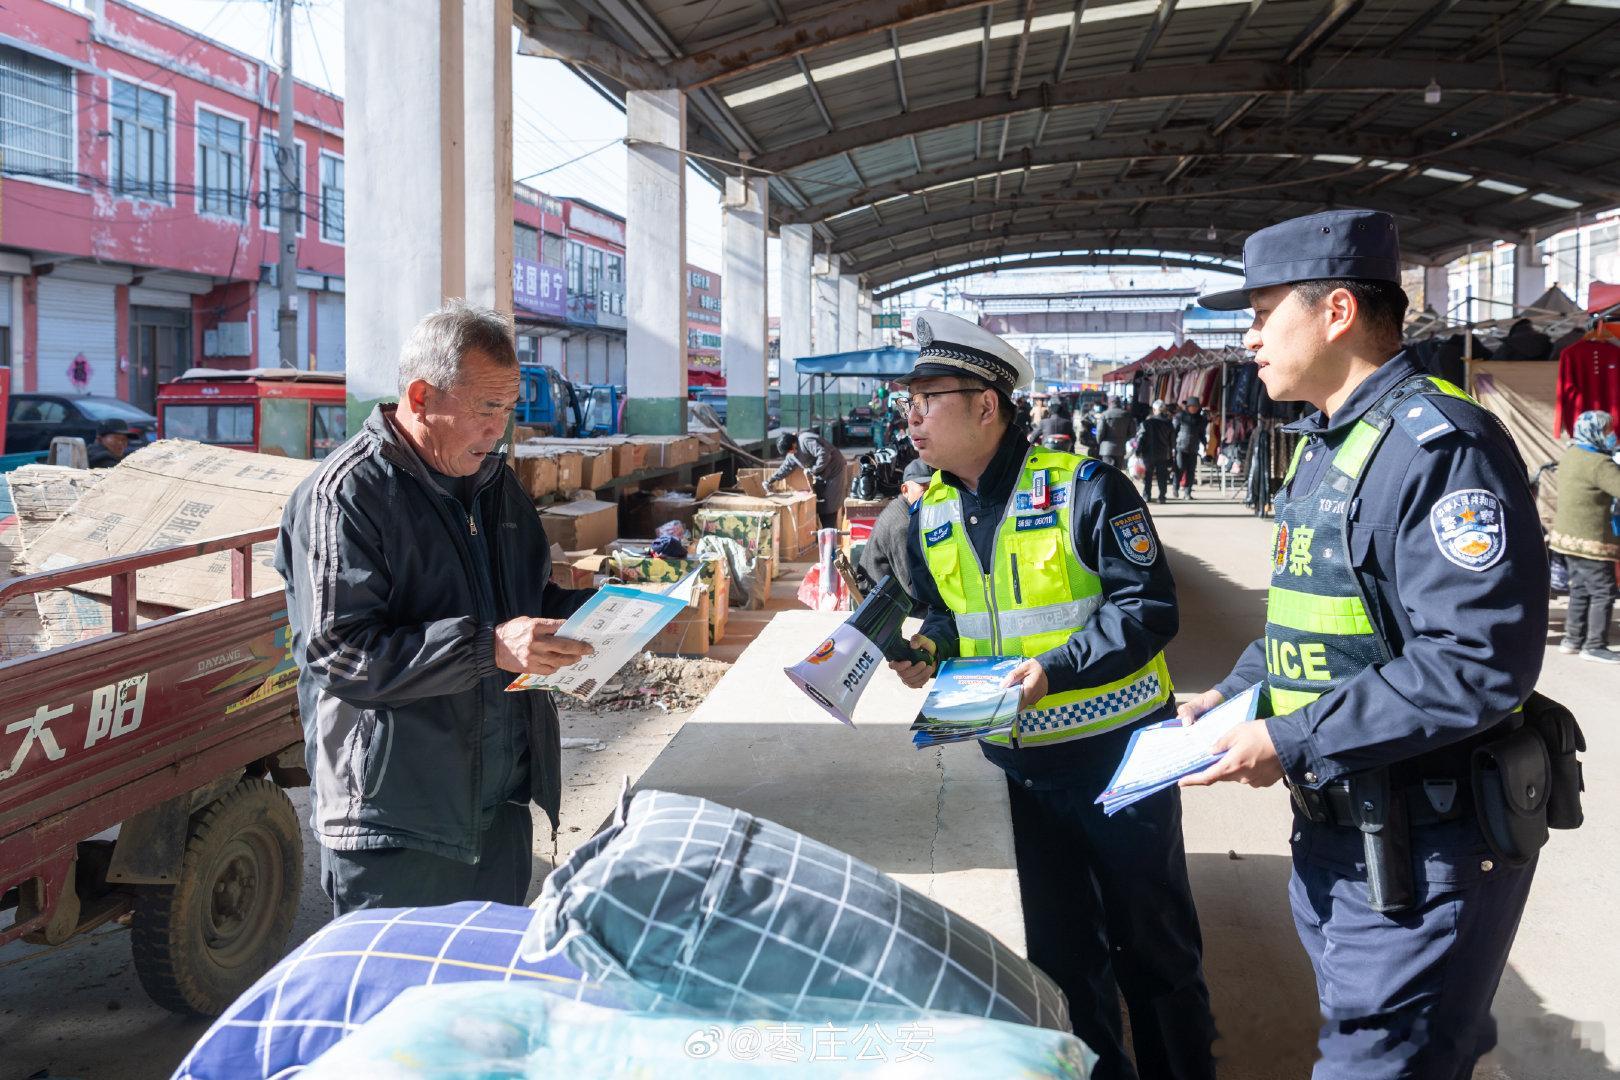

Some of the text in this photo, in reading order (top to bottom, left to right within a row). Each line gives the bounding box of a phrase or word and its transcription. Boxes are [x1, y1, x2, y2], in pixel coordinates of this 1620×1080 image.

[592, 619, 605, 630] 3
[198, 649, 241, 671] DAYANG
[569, 663, 588, 671] 10
[843, 650, 875, 692] POLICE
[554, 676, 575, 685] 12
[0, 673, 149, 781] 大阳
